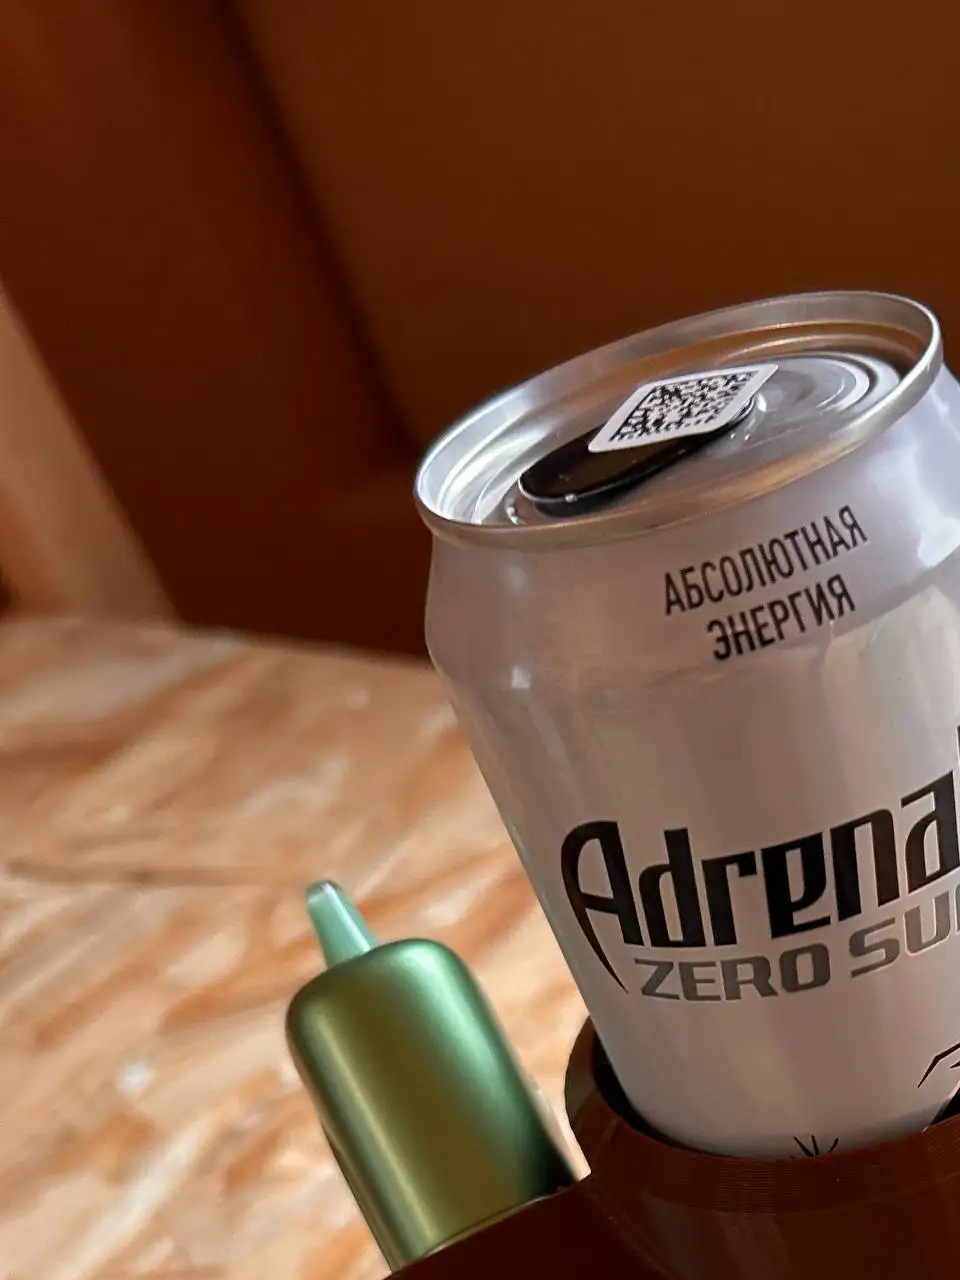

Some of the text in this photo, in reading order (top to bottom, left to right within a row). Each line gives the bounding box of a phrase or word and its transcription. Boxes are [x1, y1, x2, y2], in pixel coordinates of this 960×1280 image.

[664, 505, 868, 616] АБСОЛЮТНАЯ
[707, 574, 856, 660] ЭНЕРГИЯ
[633, 942, 832, 1002] ZERO
